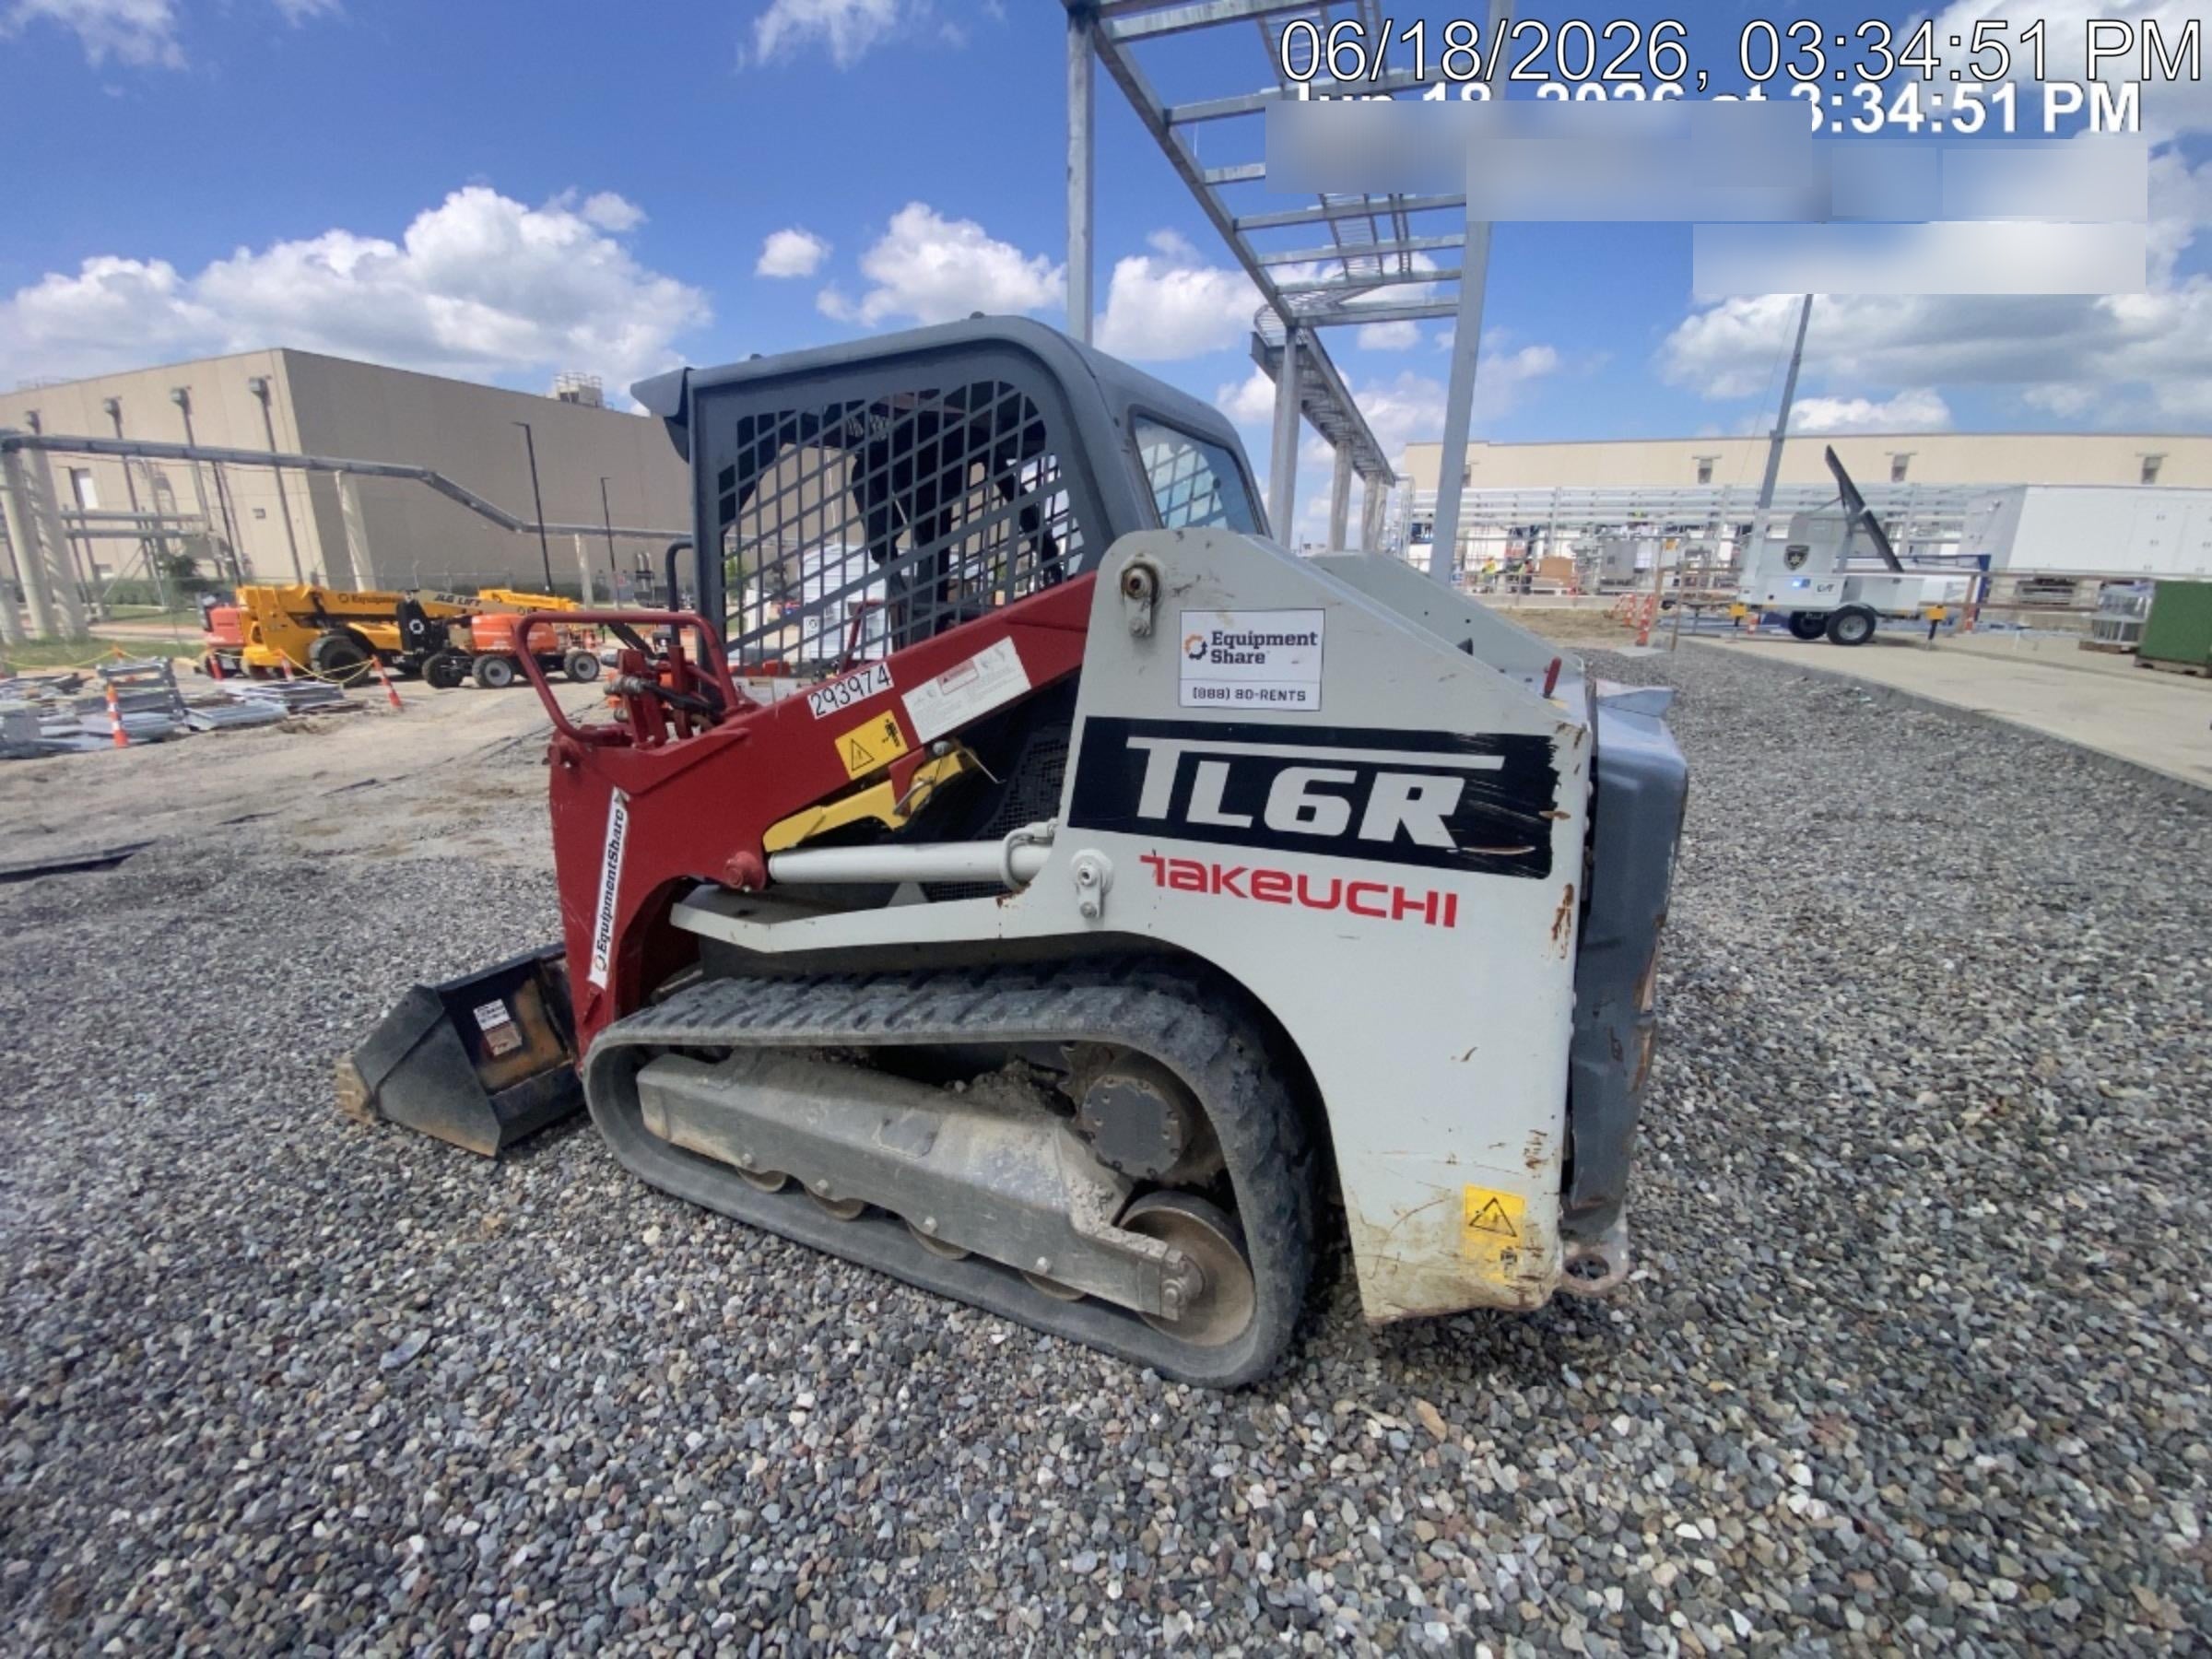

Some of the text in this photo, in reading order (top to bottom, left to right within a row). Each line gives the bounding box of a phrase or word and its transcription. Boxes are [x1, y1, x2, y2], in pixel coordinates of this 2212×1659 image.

[1210, 630, 1319, 650] Equipment
[1210, 649, 1266, 665] Share
[811, 664, 890, 716] 293974
[1193, 687, 1307, 702] (888) 80-RENTS
[1126, 735, 1506, 850] TL6R
[596, 807, 625, 955] EquipmentShare
